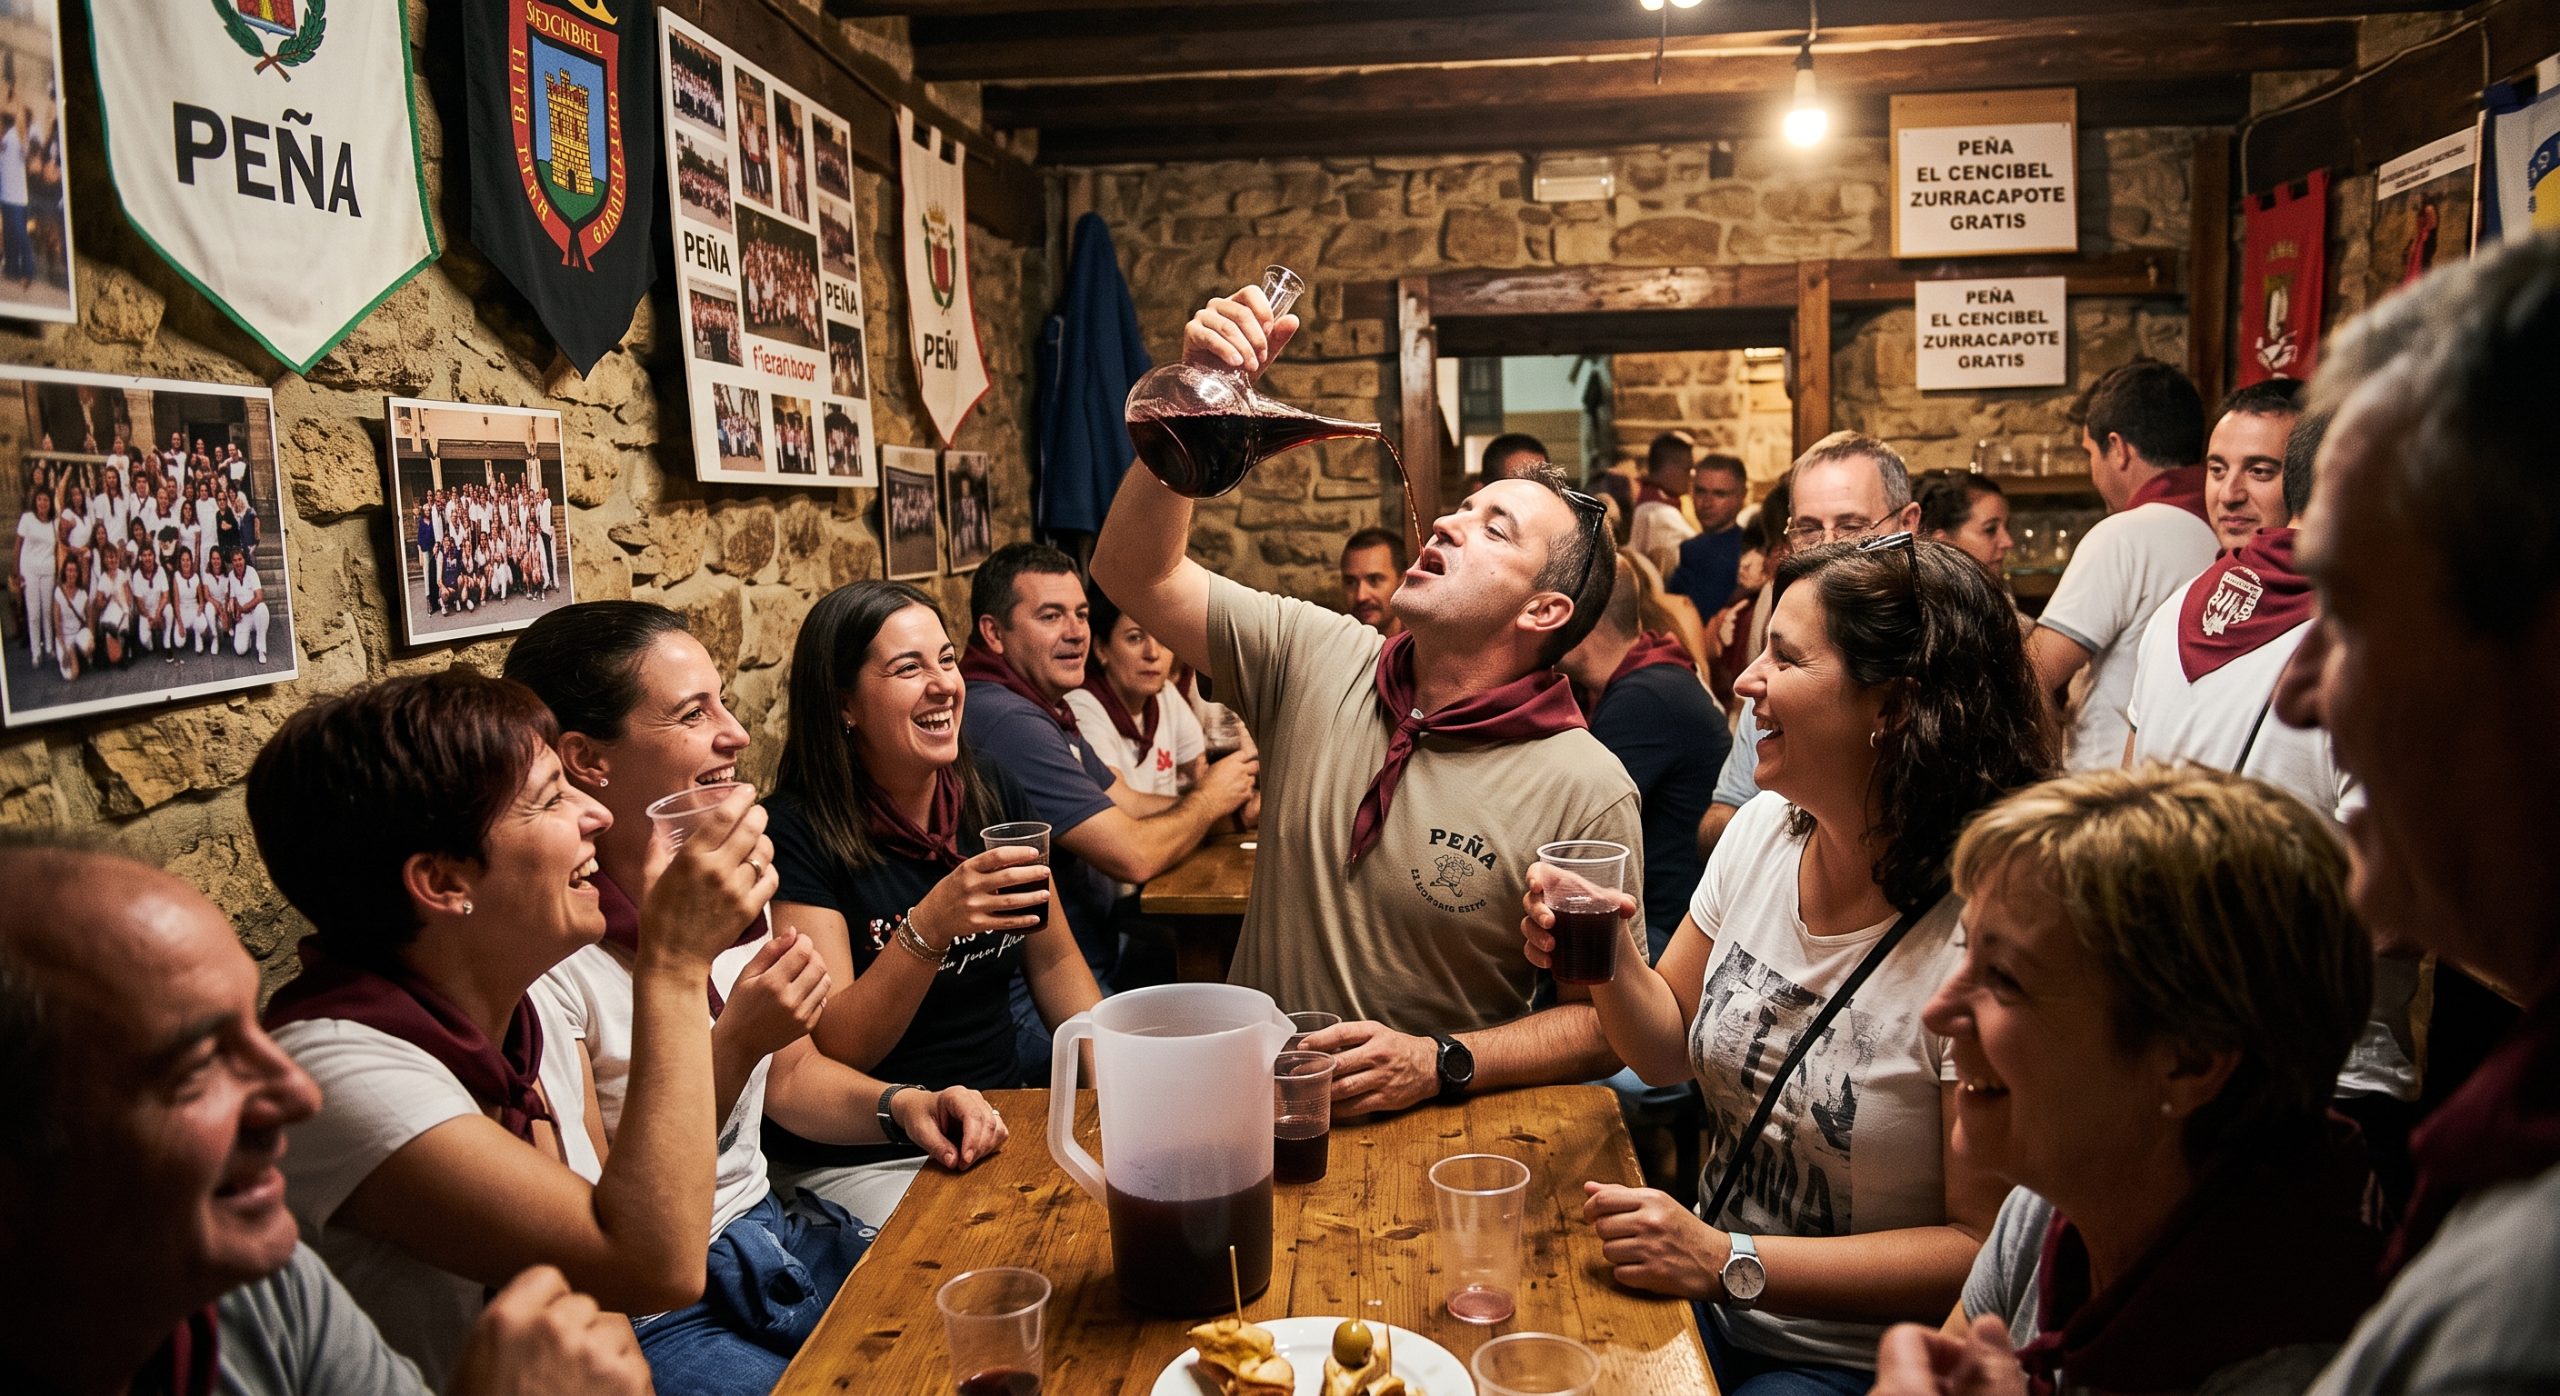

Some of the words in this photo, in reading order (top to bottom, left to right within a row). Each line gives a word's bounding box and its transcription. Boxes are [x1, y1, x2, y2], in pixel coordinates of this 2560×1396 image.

[1958, 136, 2014, 156] PEÑA
[173, 101, 362, 218] PEÑA
[1917, 167, 1941, 183] EL
[1948, 162, 2053, 182] CENCIBEL
[1911, 186, 2066, 207] ZURRACAPOTE
[1950, 212, 2026, 231] GRATIS
[683, 230, 732, 277] PEÑA
[825, 281, 858, 317] PEÑA
[1966, 286, 2015, 304] PEÑA
[1931, 314, 1951, 327] EL
[1958, 310, 2048, 327] CENCIBEL
[1923, 330, 2059, 349] ZURRACAPOTE
[1958, 353, 2025, 369] GRATIS
[1429, 828, 1498, 871] PEÑA
